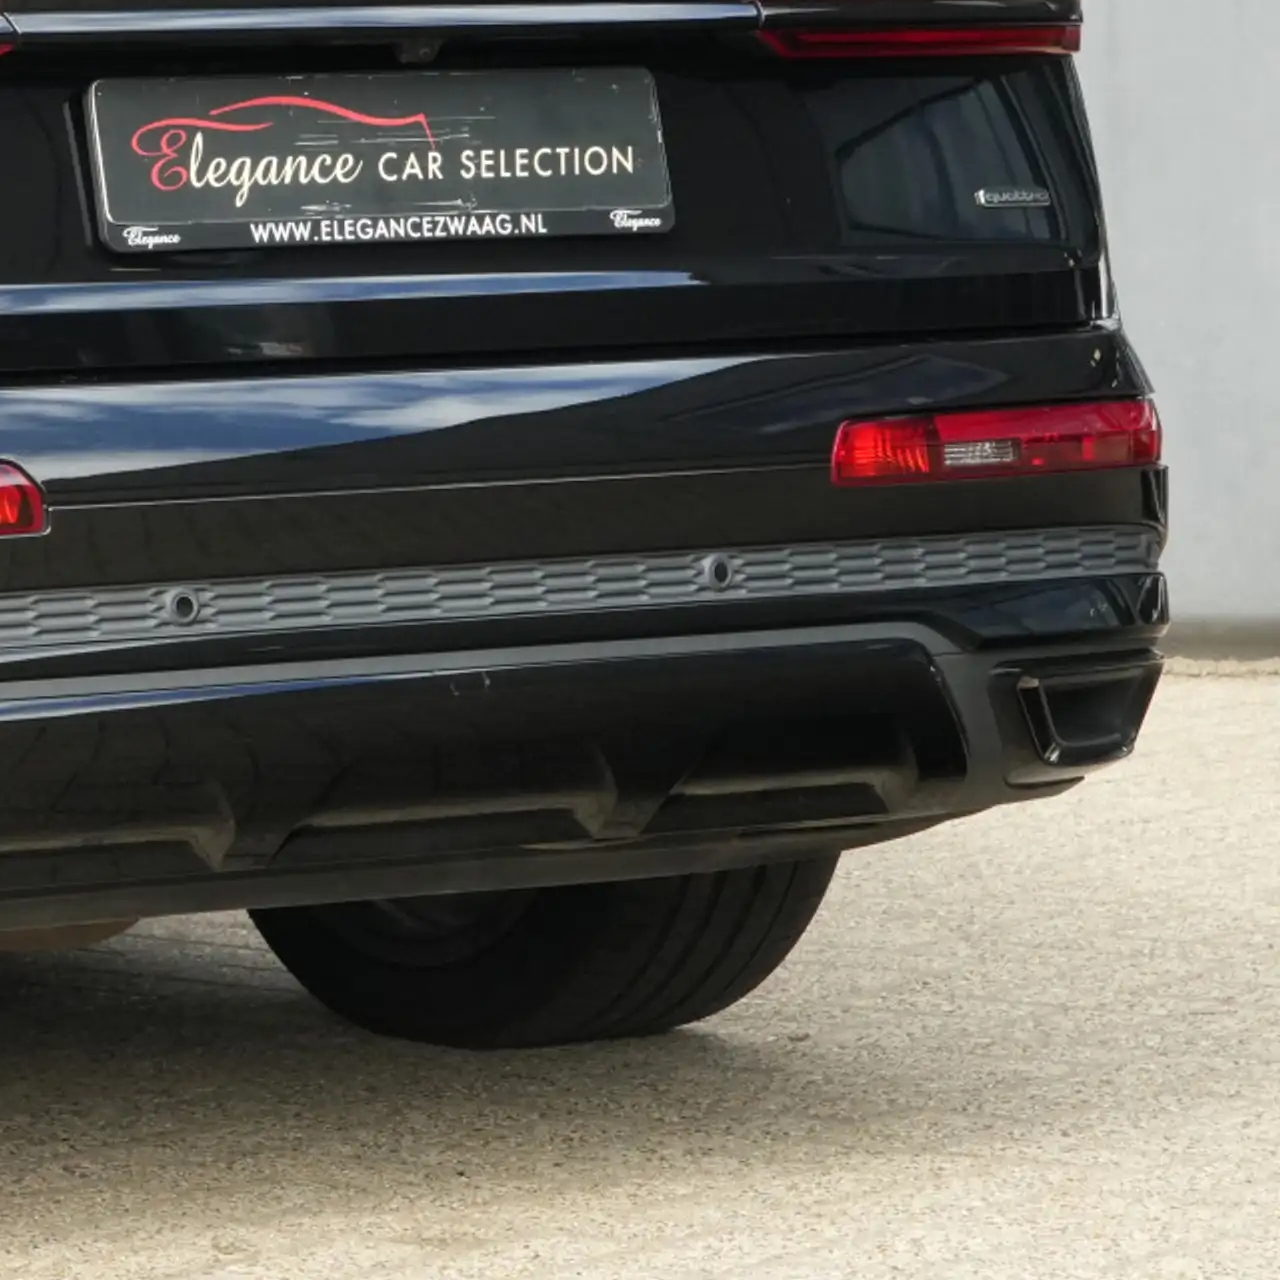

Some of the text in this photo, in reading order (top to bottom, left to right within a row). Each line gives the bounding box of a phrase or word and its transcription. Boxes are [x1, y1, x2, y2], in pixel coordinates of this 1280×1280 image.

[132, 117, 634, 208] Elegance CAR SELECTION
[249, 213, 548, 245] WWW.ELEGANCEZWAAG.NL
